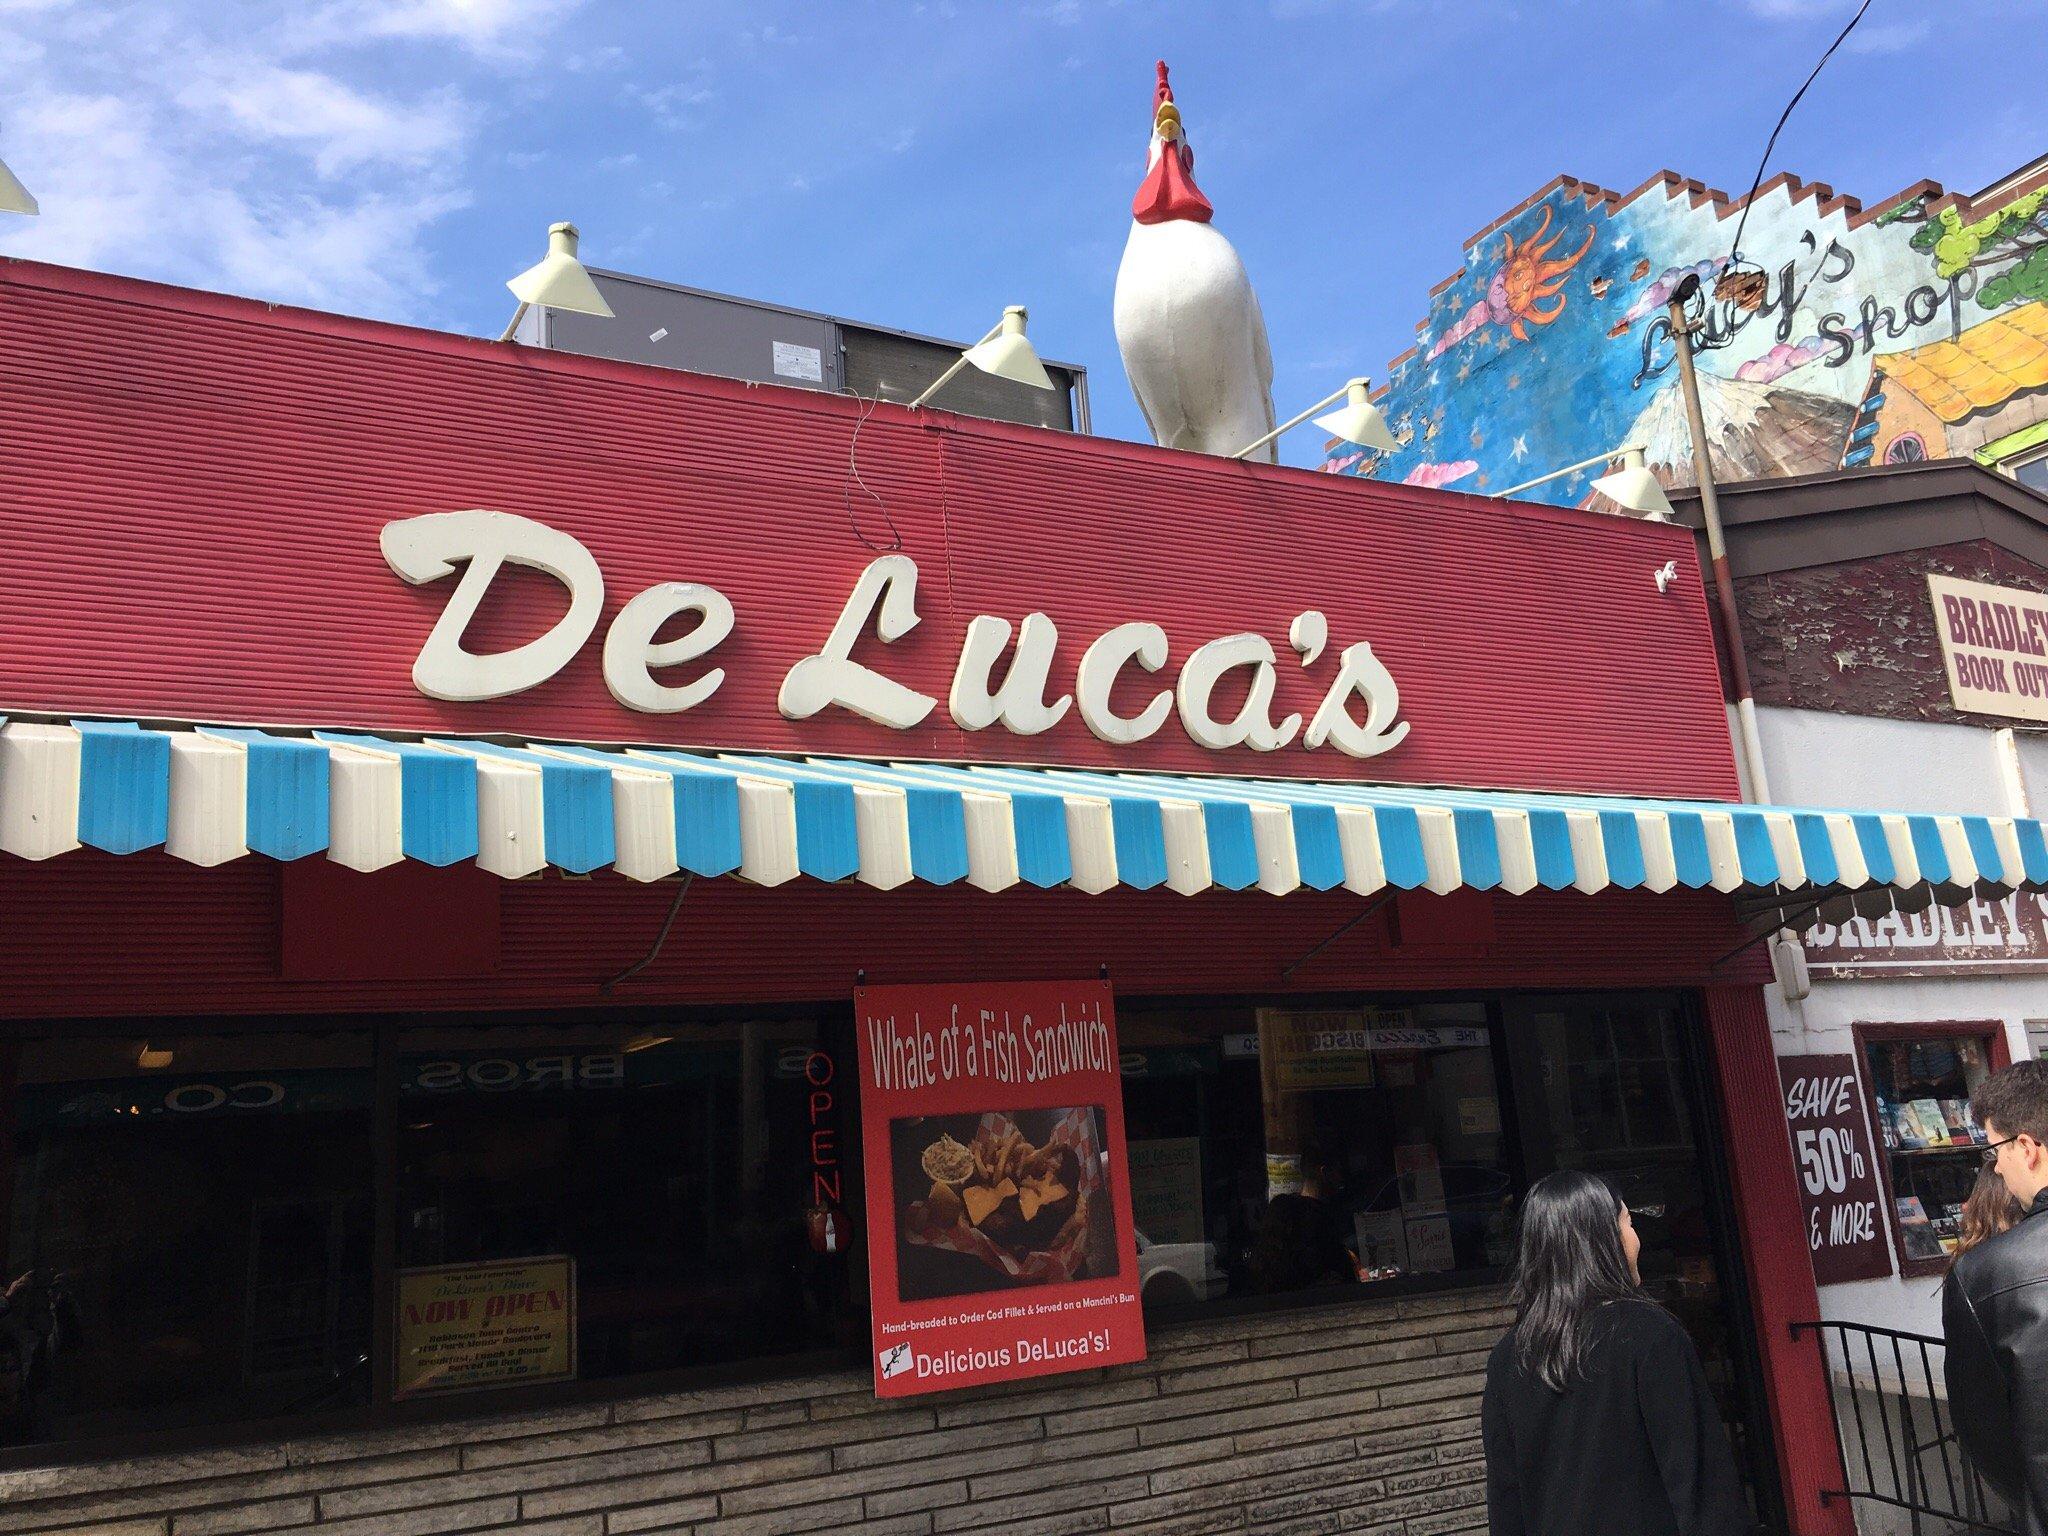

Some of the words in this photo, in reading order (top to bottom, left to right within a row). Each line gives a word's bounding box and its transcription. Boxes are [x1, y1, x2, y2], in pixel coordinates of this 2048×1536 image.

[379, 508, 735, 715] De
[777, 553, 1411, 759] Luca's
[1953, 651, 2011, 694] BOOK
[867, 1012, 936, 1090] Whale
[940, 1003, 960, 1081] of
[964, 1024, 978, 1077] a
[980, 1009, 1021, 1084] Fish
[1023, 1001, 1112, 1083] Sandwich
[1786, 1074, 1856, 1120] SAVE
[804, 1051, 841, 1207] OPEN
[1797, 1126, 1866, 1197] 50%
[1810, 1214, 1824, 1251] &
[1829, 1200, 1876, 1246] MORE
[404, 1297, 475, 1326] NOW
[484, 1289, 566, 1318] OPEN
[881, 1315, 947, 1334] Hand-breaded
[948, 1315, 959, 1327] to
[959, 1312, 985, 1324] Order
[986, 1308, 1004, 1321] Cod
[1004, 1305, 1026, 1318] Fillet
[1027, 1304, 1034, 1315] &
[1035, 1301, 1063, 1314] Served
[1063, 1301, 1075, 1311] on
[1075, 1300, 1082, 1309] a
[1082, 1294, 1119, 1309] Mancini's
[1119, 1293, 1136, 1304] Bun
[916, 1345, 1011, 1379] Delicious
[1016, 1328, 1111, 1364] DeLuca's!
